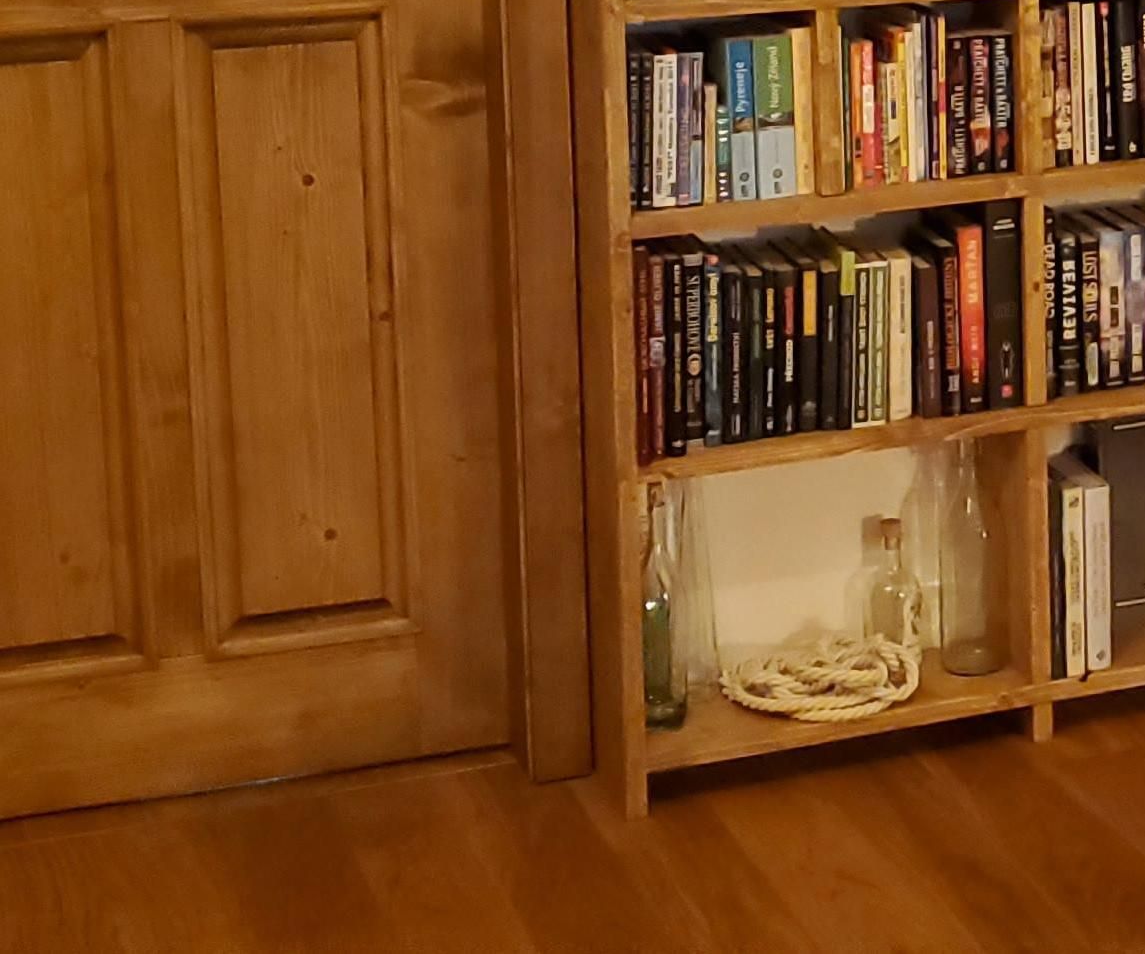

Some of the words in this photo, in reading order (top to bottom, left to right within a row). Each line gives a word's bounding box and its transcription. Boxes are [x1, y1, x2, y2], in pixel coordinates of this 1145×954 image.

[973, 38, 988, 87] PRATCHETT
[995, 37, 1009, 87] PRATCHETT
[734, 62, 750, 114] Pyreneje
[950, 85, 966, 118] BAXTER
[995, 94, 1011, 129] BAXTER
[952, 128, 967, 175] PRATCHETT
[1081, 250, 1097, 280] LOST
[1081, 281, 1098, 322] SOULS
